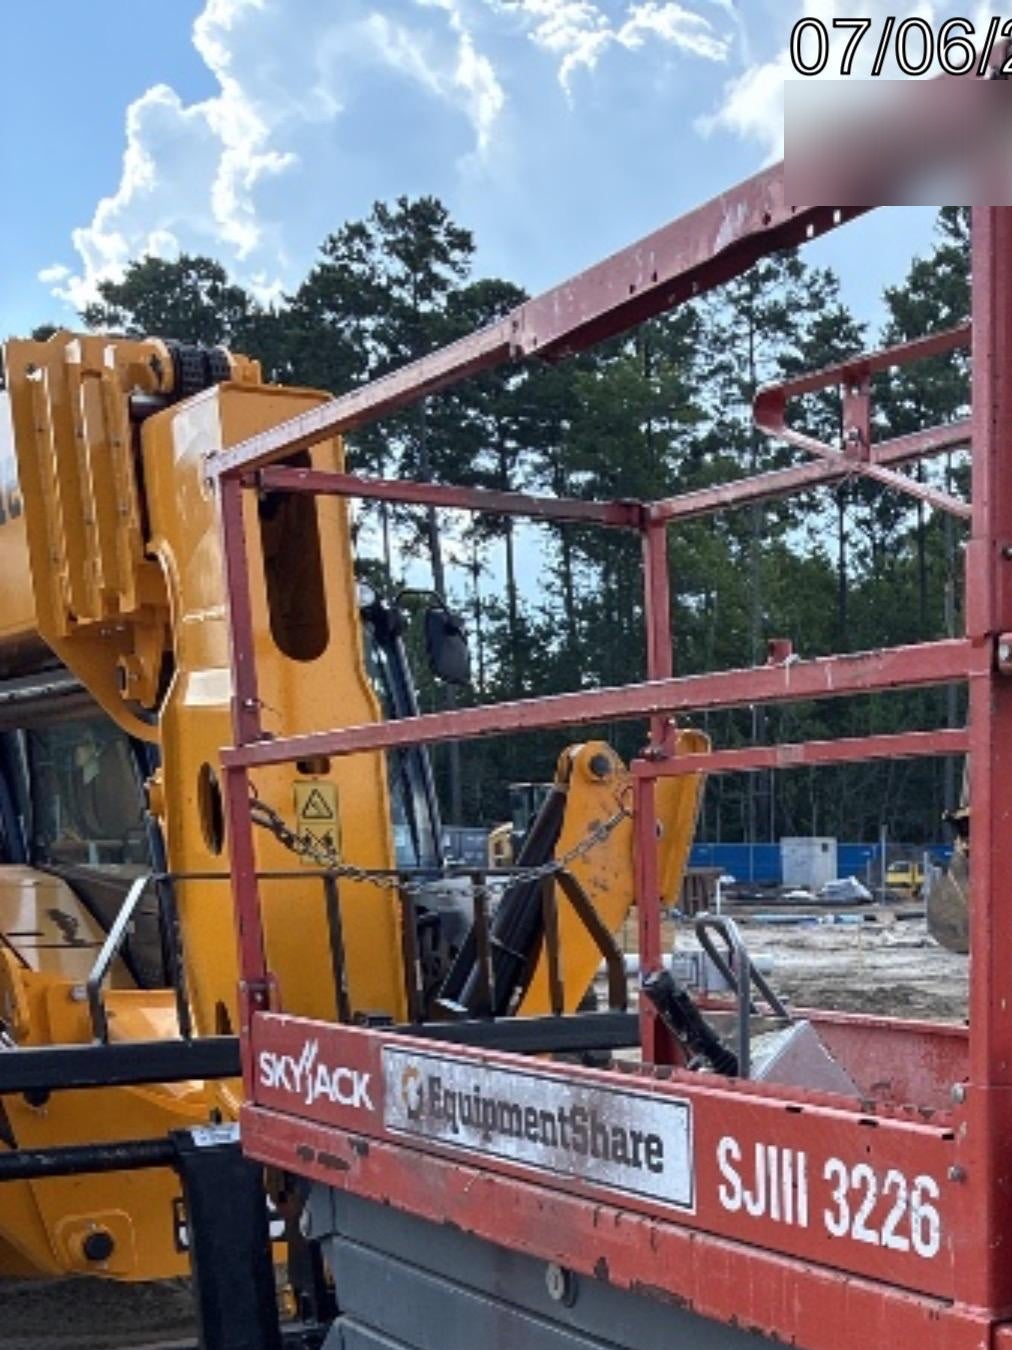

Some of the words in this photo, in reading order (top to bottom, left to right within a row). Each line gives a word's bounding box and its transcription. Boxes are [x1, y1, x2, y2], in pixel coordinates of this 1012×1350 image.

[258, 1038, 375, 1110] SKYJACK
[427, 1075, 664, 1174] EquipmentShare
[716, 1136, 809, 1229] SJIII
[823, 1157, 941, 1258] 3226
